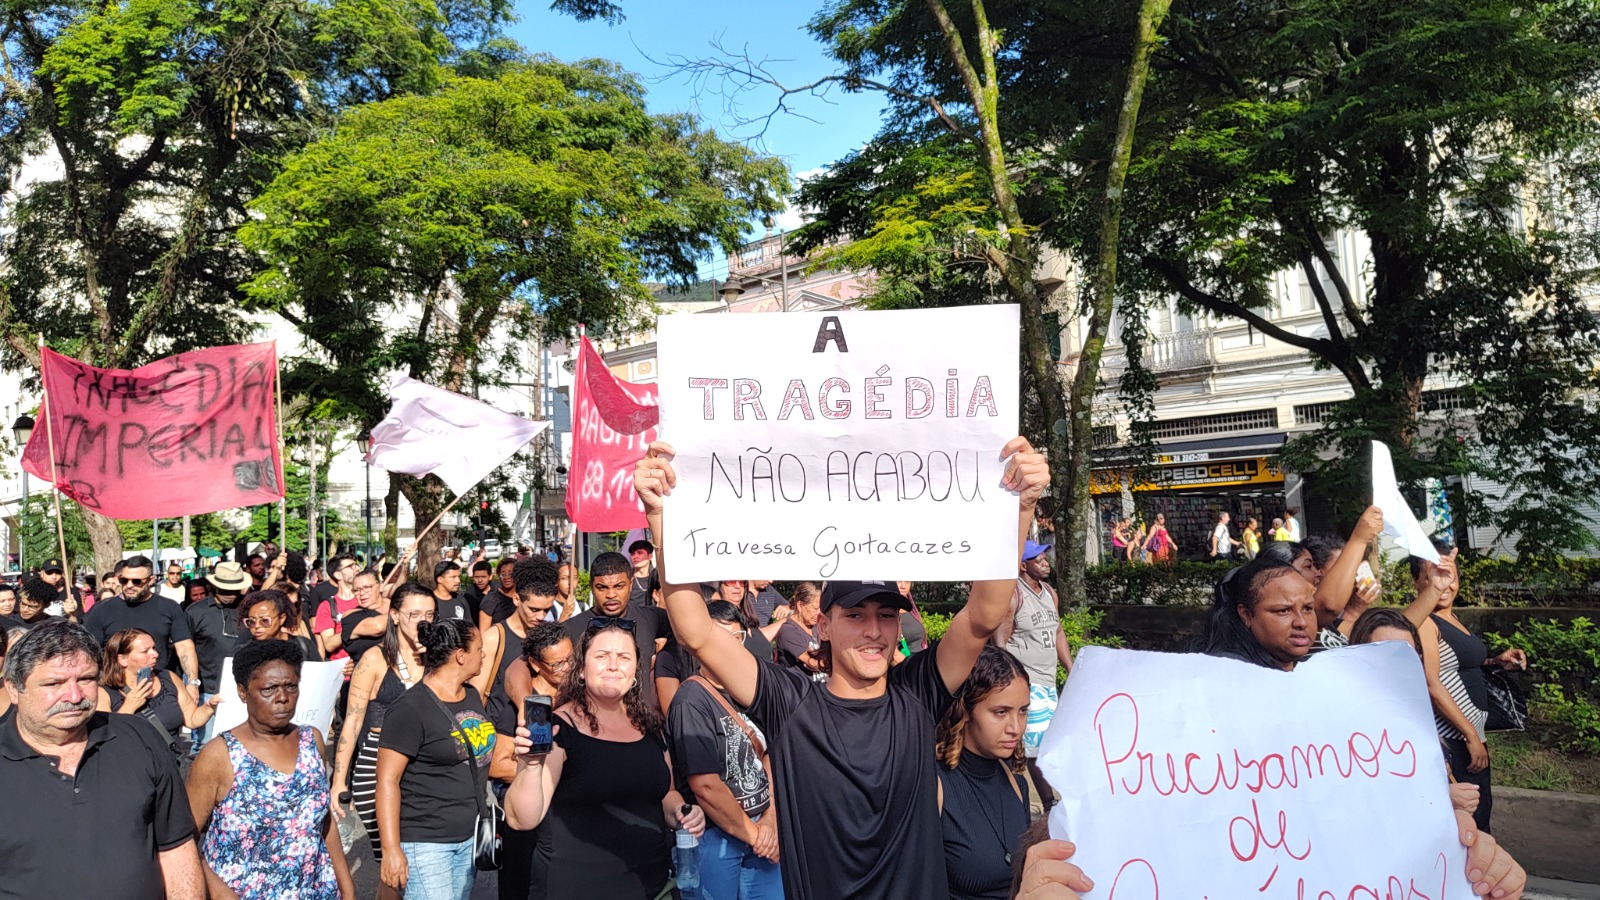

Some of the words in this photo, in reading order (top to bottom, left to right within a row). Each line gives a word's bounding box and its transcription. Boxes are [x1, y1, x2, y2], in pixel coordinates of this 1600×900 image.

[812, 315, 849, 353] A
[688, 364, 998, 421] TRAGÉDIA
[54, 416, 272, 477] IMPERIAL
[706, 446, 806, 503] NÃO
[827, 450, 985, 502] ACABOU
[683, 527, 796, 558] Travessa
[1042, 630, 1055, 648] 21
[1093, 692, 1417, 795] Precisamos
[1229, 799, 1312, 862] de
